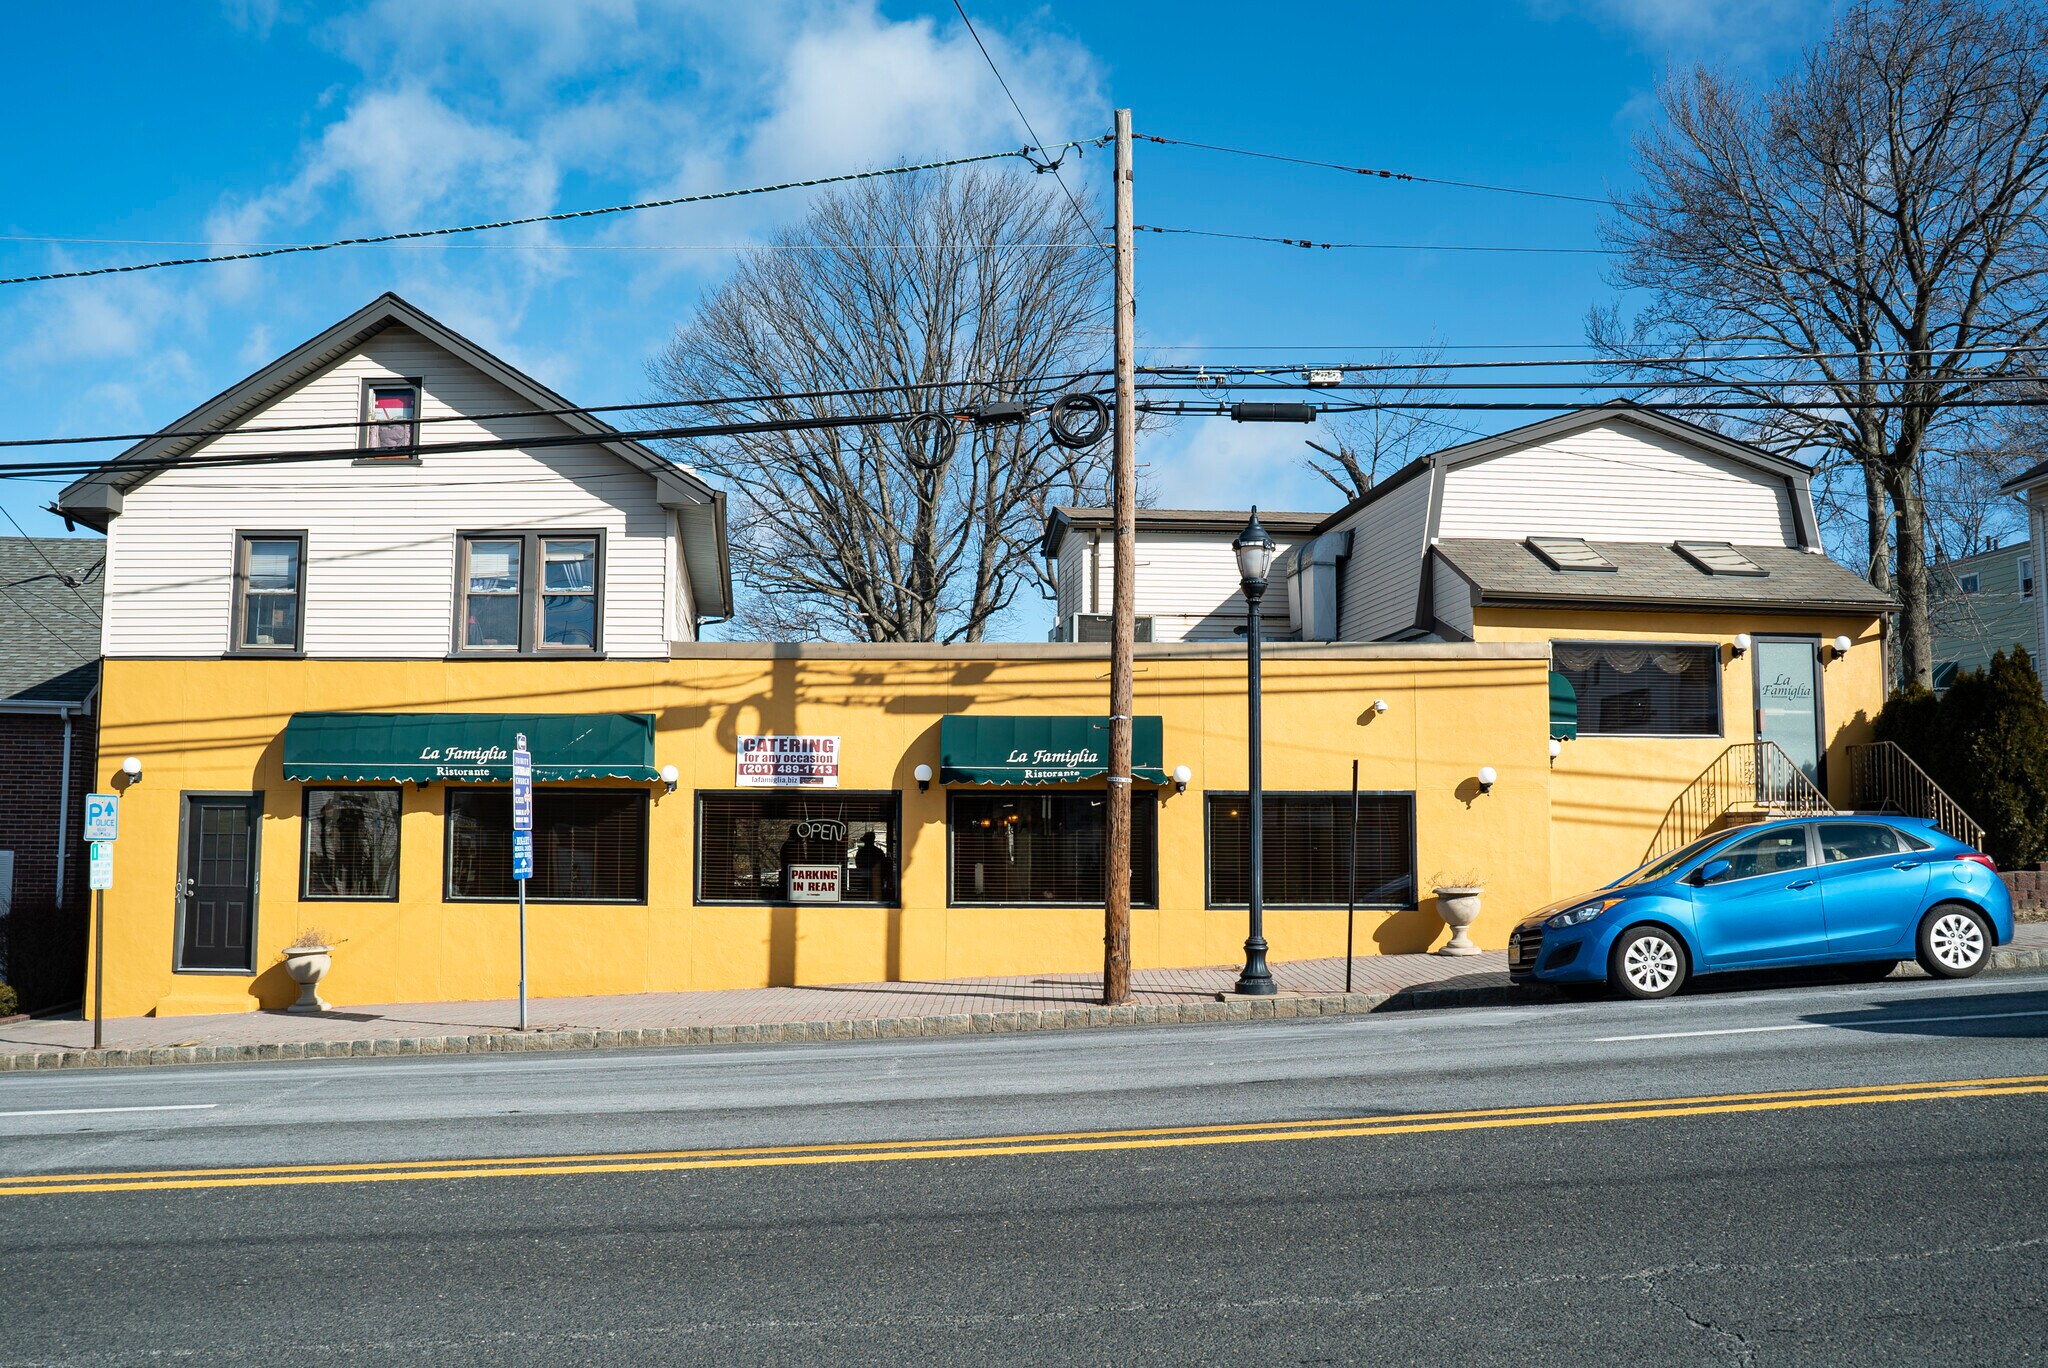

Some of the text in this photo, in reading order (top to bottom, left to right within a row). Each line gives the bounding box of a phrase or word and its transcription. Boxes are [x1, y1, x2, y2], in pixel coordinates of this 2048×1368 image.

[1773, 673, 1790, 685] La
[1762, 683, 1811, 701] Famiglia
[743, 738, 834, 753] CATERING
[419, 745, 507, 765] La Famiglia
[744, 752, 833, 764] for any occasion
[1006, 748, 1098, 768] La Famiglia
[436, 766, 490, 776] Ristorante
[743, 764, 833, 775] (201) 489-1713
[1024, 769, 1080, 779] Ristorante
[751, 776, 798, 785] lafamiglia.biz
[797, 822, 844, 842] OPEN
[791, 870, 838, 880] PARKING
[793, 882, 835, 892] IN REAR
